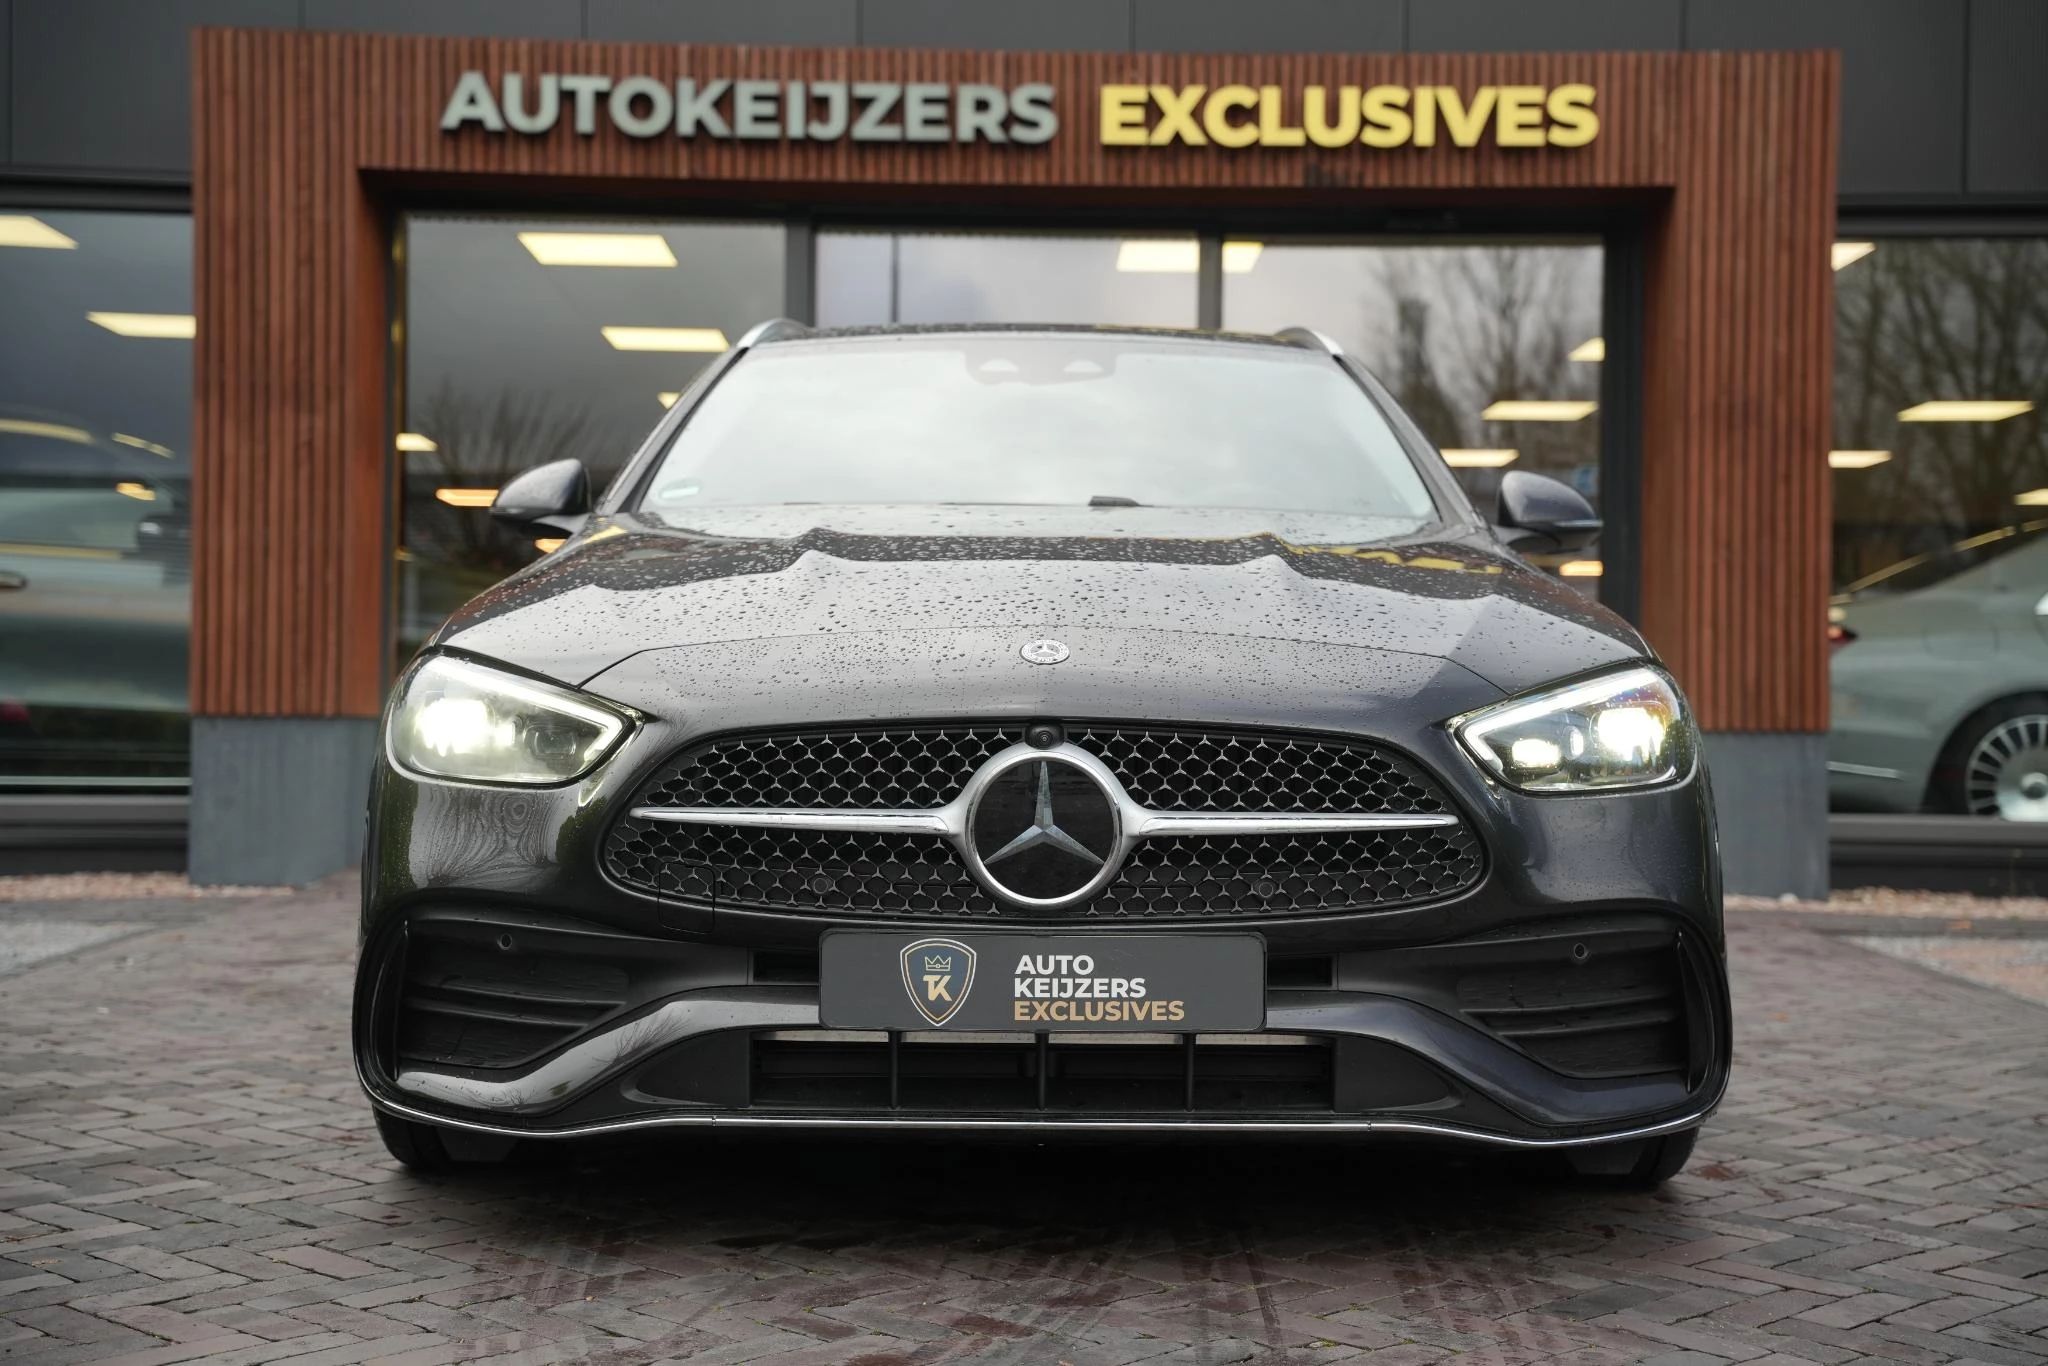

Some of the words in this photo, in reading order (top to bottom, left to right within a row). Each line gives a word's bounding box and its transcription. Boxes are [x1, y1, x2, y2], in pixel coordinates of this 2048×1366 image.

[440, 71, 1059, 144] AUTOKEIJZERS
[1100, 84, 1600, 148] EXCLUSIVES
[1014, 954, 1095, 976] AUTO
[1014, 977, 1147, 999] KEIJZERS
[1014, 1000, 1185, 1022] EXCLUSIVES
